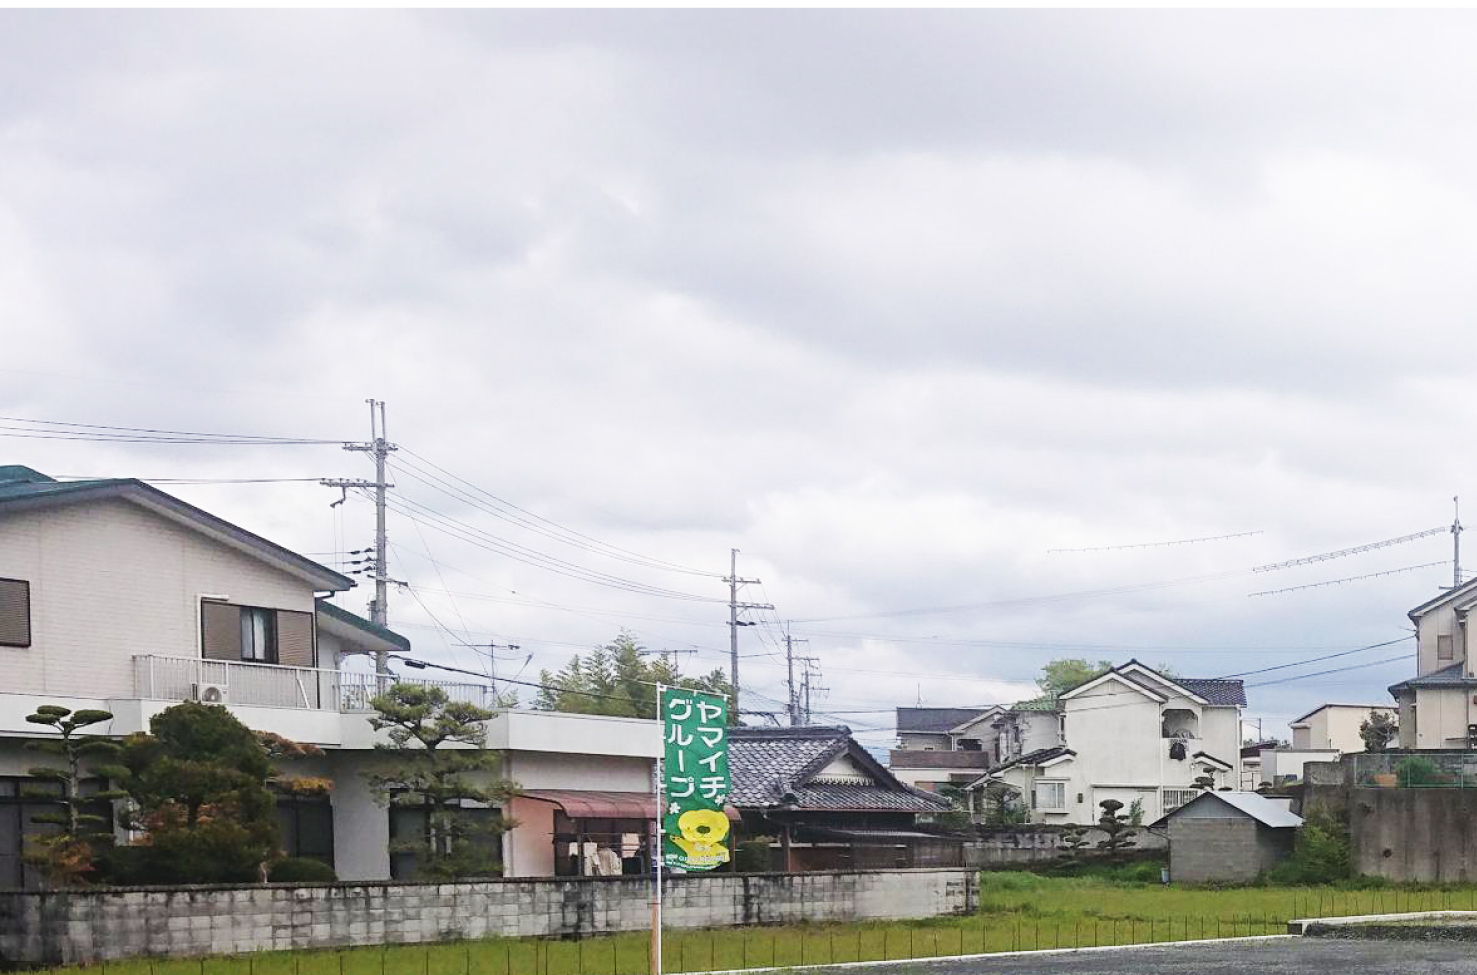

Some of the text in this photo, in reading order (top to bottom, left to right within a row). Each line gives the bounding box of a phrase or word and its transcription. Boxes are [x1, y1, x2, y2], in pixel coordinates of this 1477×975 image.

[668, 698, 694, 797] グループ
[697, 701, 726, 798] ヤマイチ
